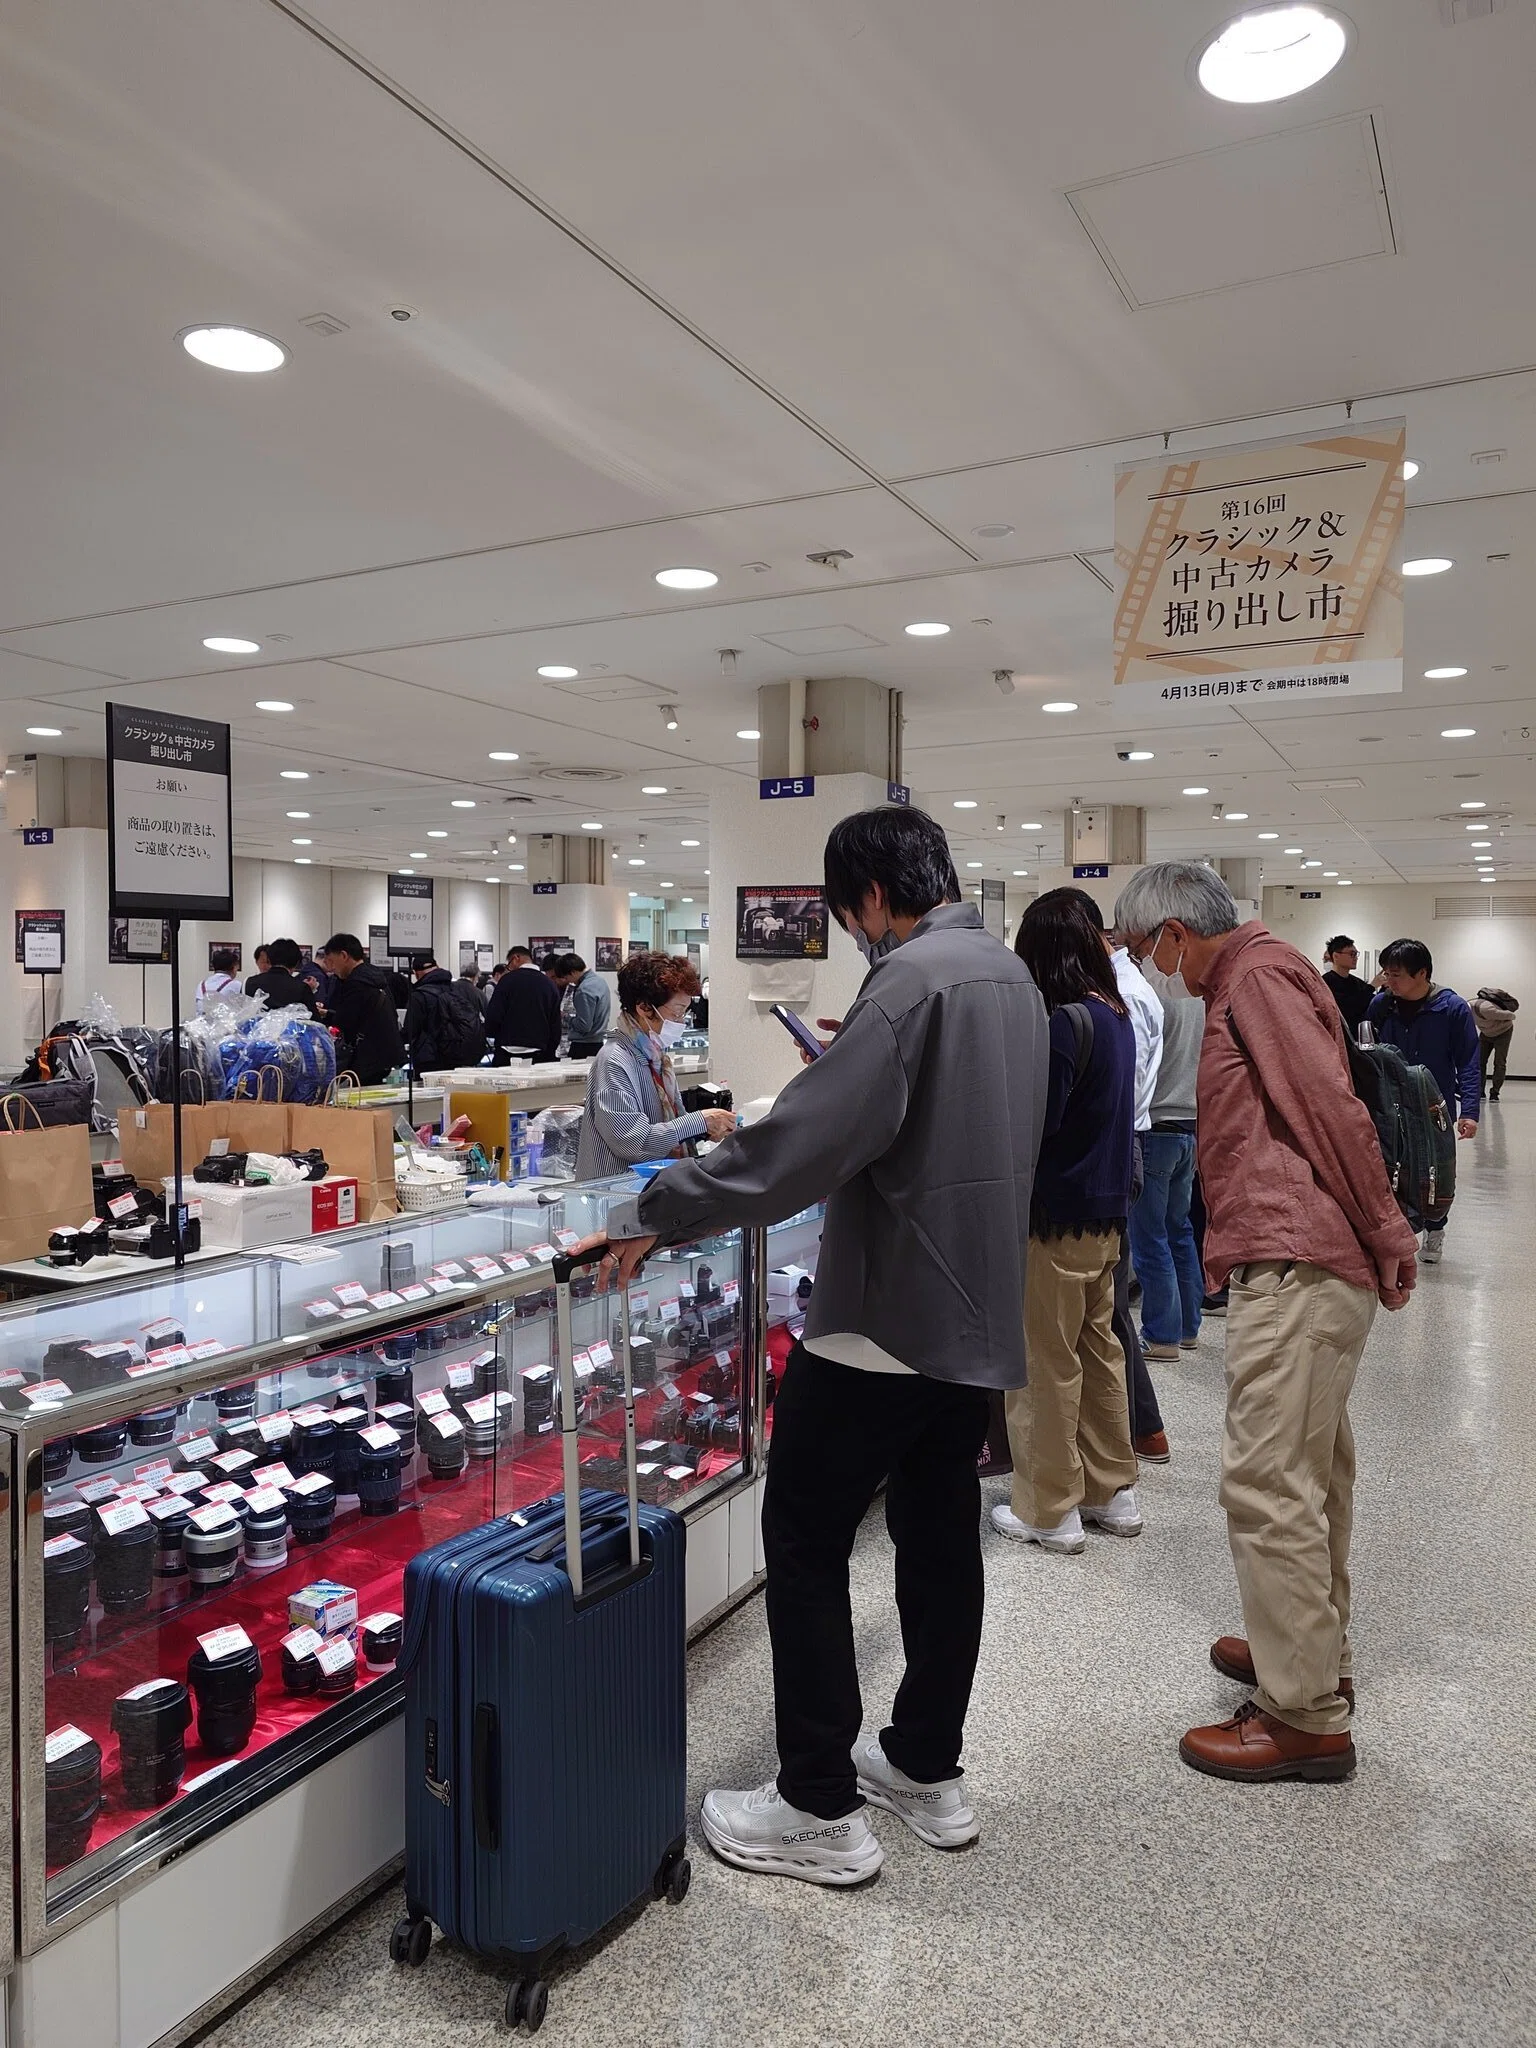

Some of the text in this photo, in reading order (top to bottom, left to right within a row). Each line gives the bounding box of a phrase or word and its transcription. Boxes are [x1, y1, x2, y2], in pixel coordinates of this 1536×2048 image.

[1221, 494, 1286, 521] 第16回
[1165, 510, 1346, 560] クラシック&
[1172, 548, 1335, 594] 中古カメラ
[1162, 583, 1346, 638] 掘り出し市
[1160, 678, 1263, 700] 4月13日(月)まで
[150, 744, 193, 762] 掘り出し市
[156, 779, 188, 793] お願い
[770, 781, 804, 795] J-5
[891, 787, 906, 802] J-5
[28, 832, 48, 843] K-5
[127, 816, 216, 838] 商品の取り置きは、
[134, 840, 211, 860] ご遠慮ください。
[1081, 868, 1101, 877] J-4
[781, 1822, 851, 1845] SKECHERS
